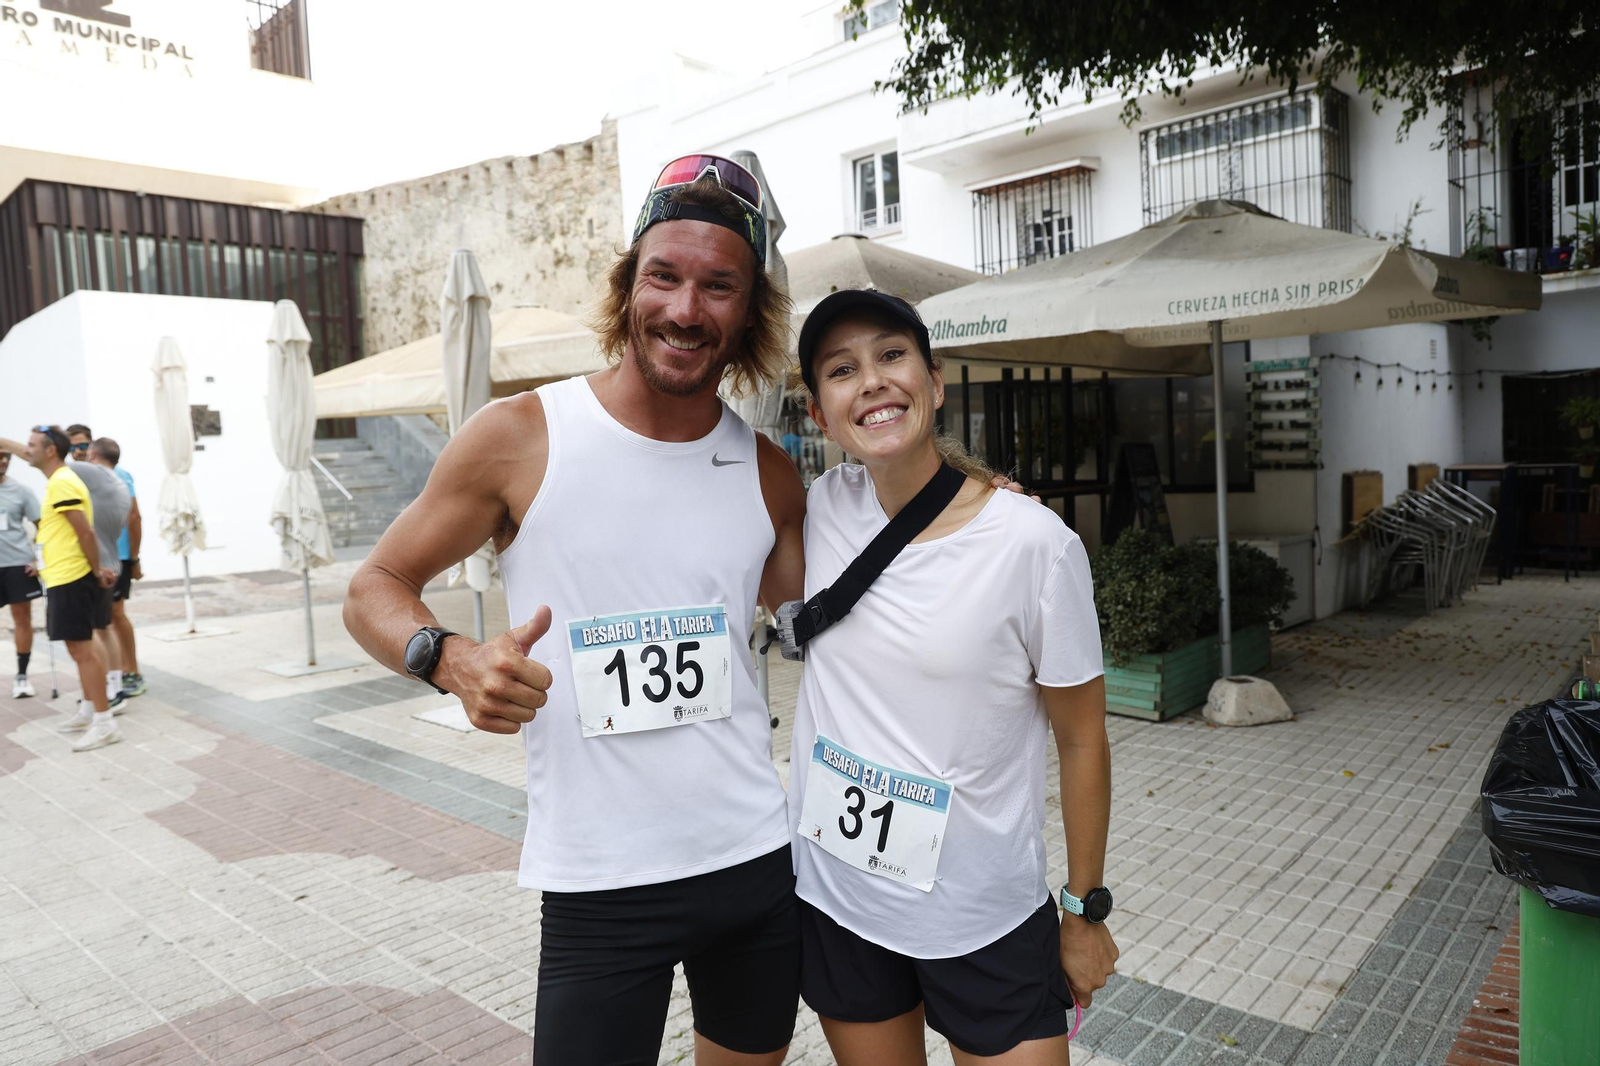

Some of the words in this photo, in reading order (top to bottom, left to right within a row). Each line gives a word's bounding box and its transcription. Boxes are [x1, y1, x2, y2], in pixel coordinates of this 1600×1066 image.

[53, 17, 193, 60] MUNICIPAL
[1168, 295, 1227, 315] CERVEZA
[1232, 287, 1279, 308] HECHA
[1285, 284, 1311, 301] SIN
[1318, 277, 1365, 297] PRISA
[928, 314, 1007, 340] Alhambra
[582, 619, 637, 646] DESAFÍO
[639, 614, 674, 643] ELA
[673, 615, 715, 636] TARIFA
[604, 641, 704, 707] 135
[683, 706, 709, 716] TARIFA
[822, 745, 860, 779] DESAFÍO
[861, 763, 891, 797] ELA
[893, 777, 936, 806] TARIFA
[838, 785, 894, 853] 31
[878, 861, 907, 876] TARIFA
